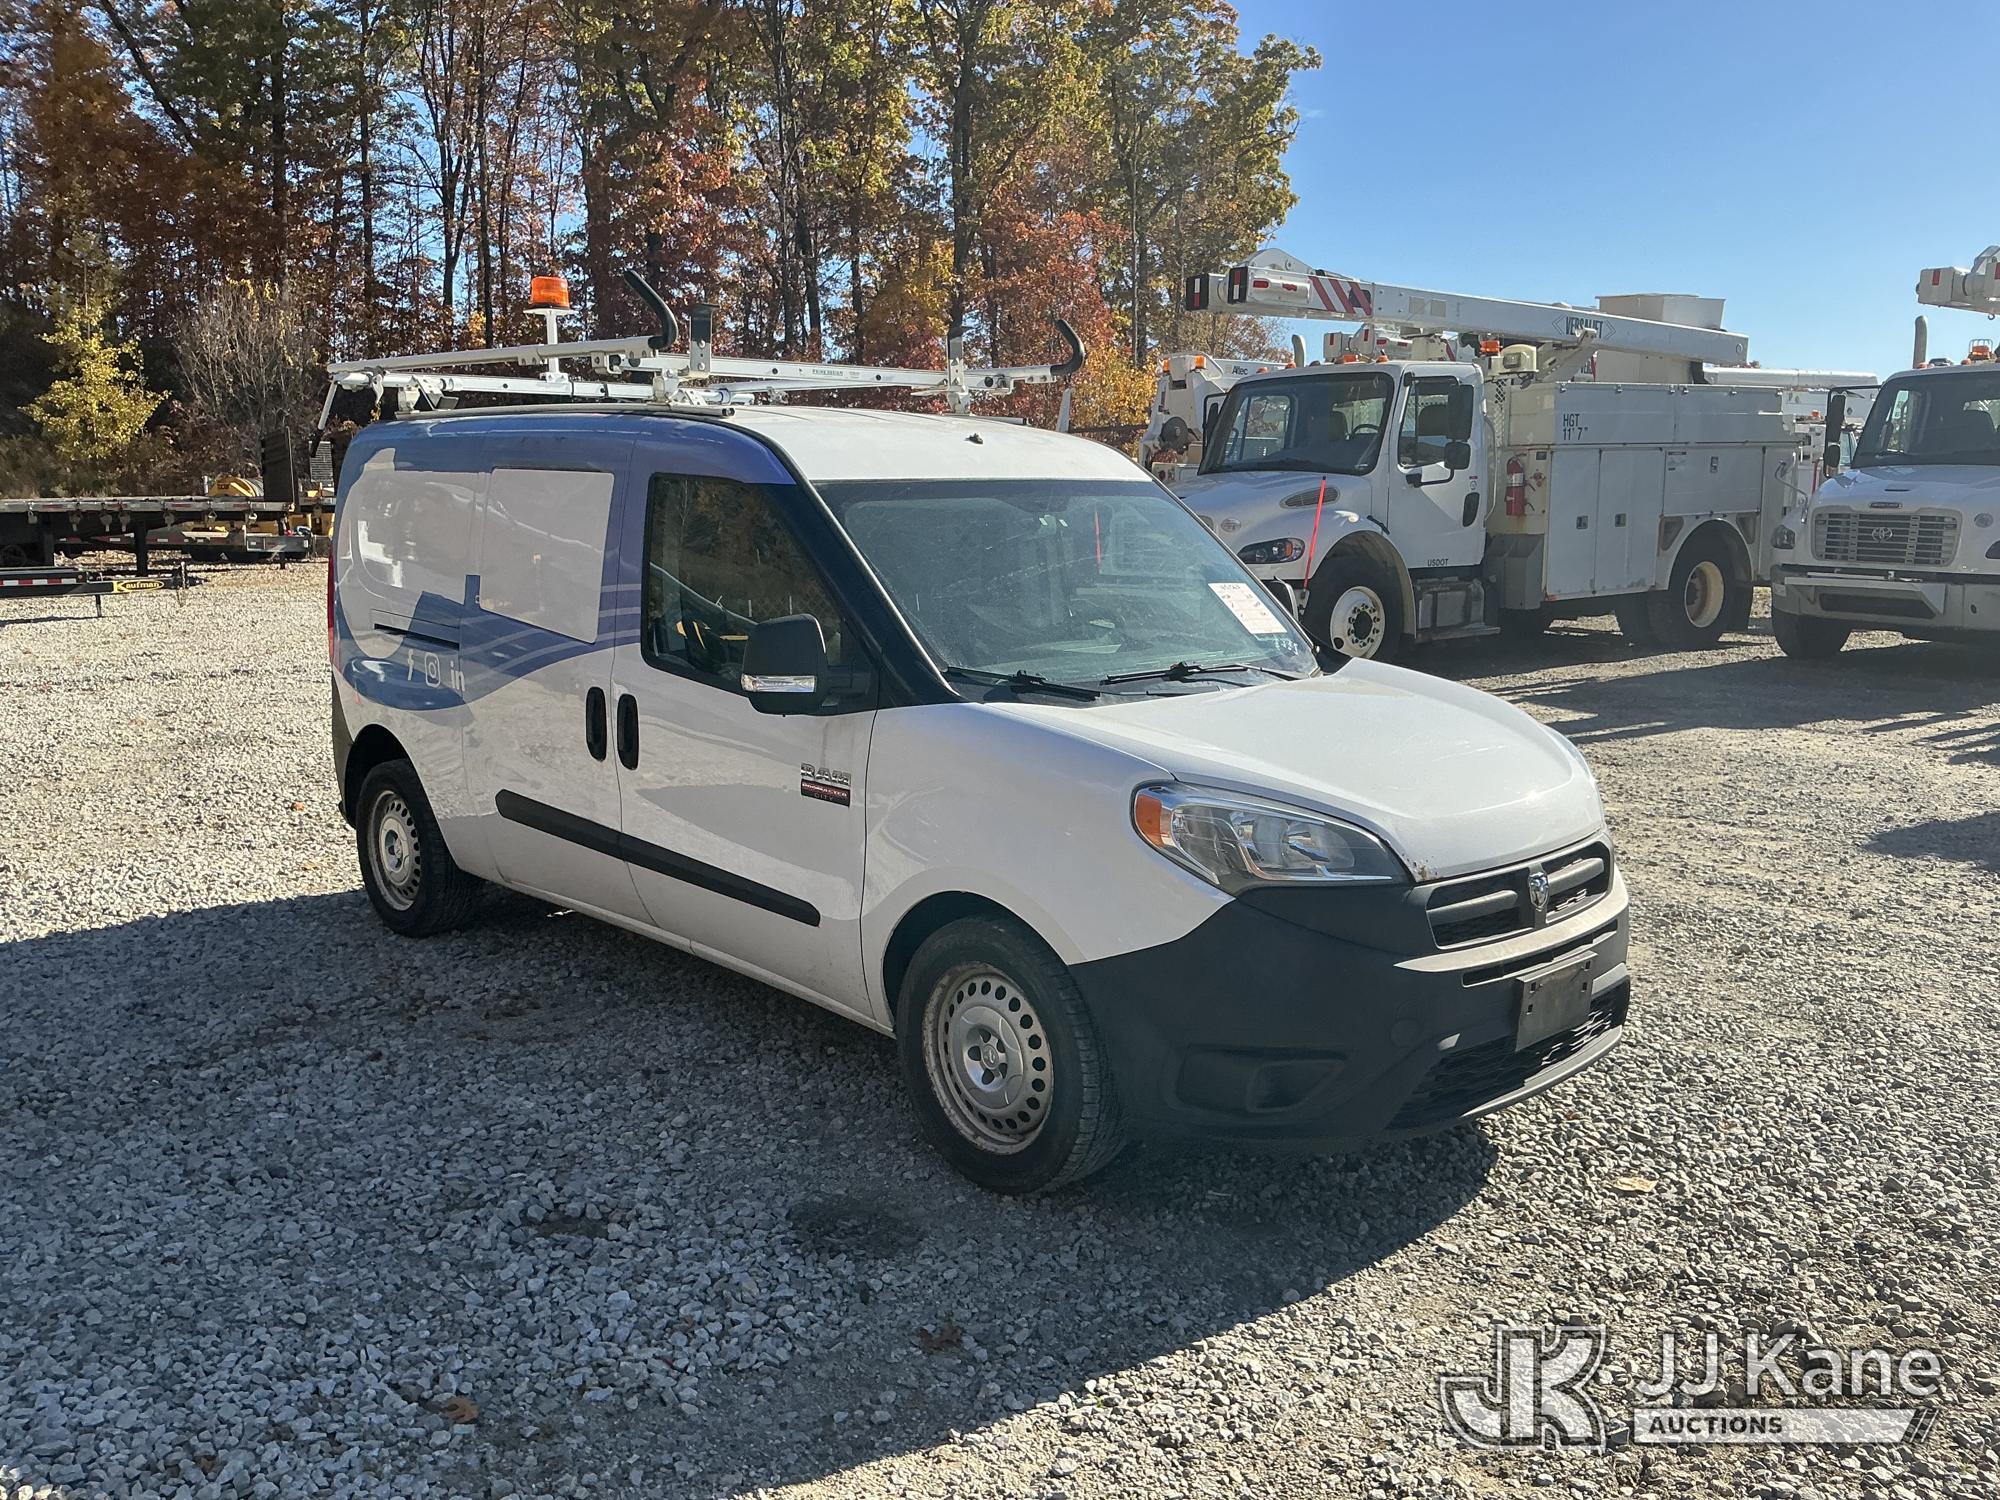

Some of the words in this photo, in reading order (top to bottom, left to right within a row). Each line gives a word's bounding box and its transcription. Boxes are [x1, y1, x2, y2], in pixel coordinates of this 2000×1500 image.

[1562, 413, 1580, 427] HGT
[1427, 558, 1449, 567] USDOT
[112, 580, 163, 593] Kaufman
[800, 762, 852, 786] RAM
